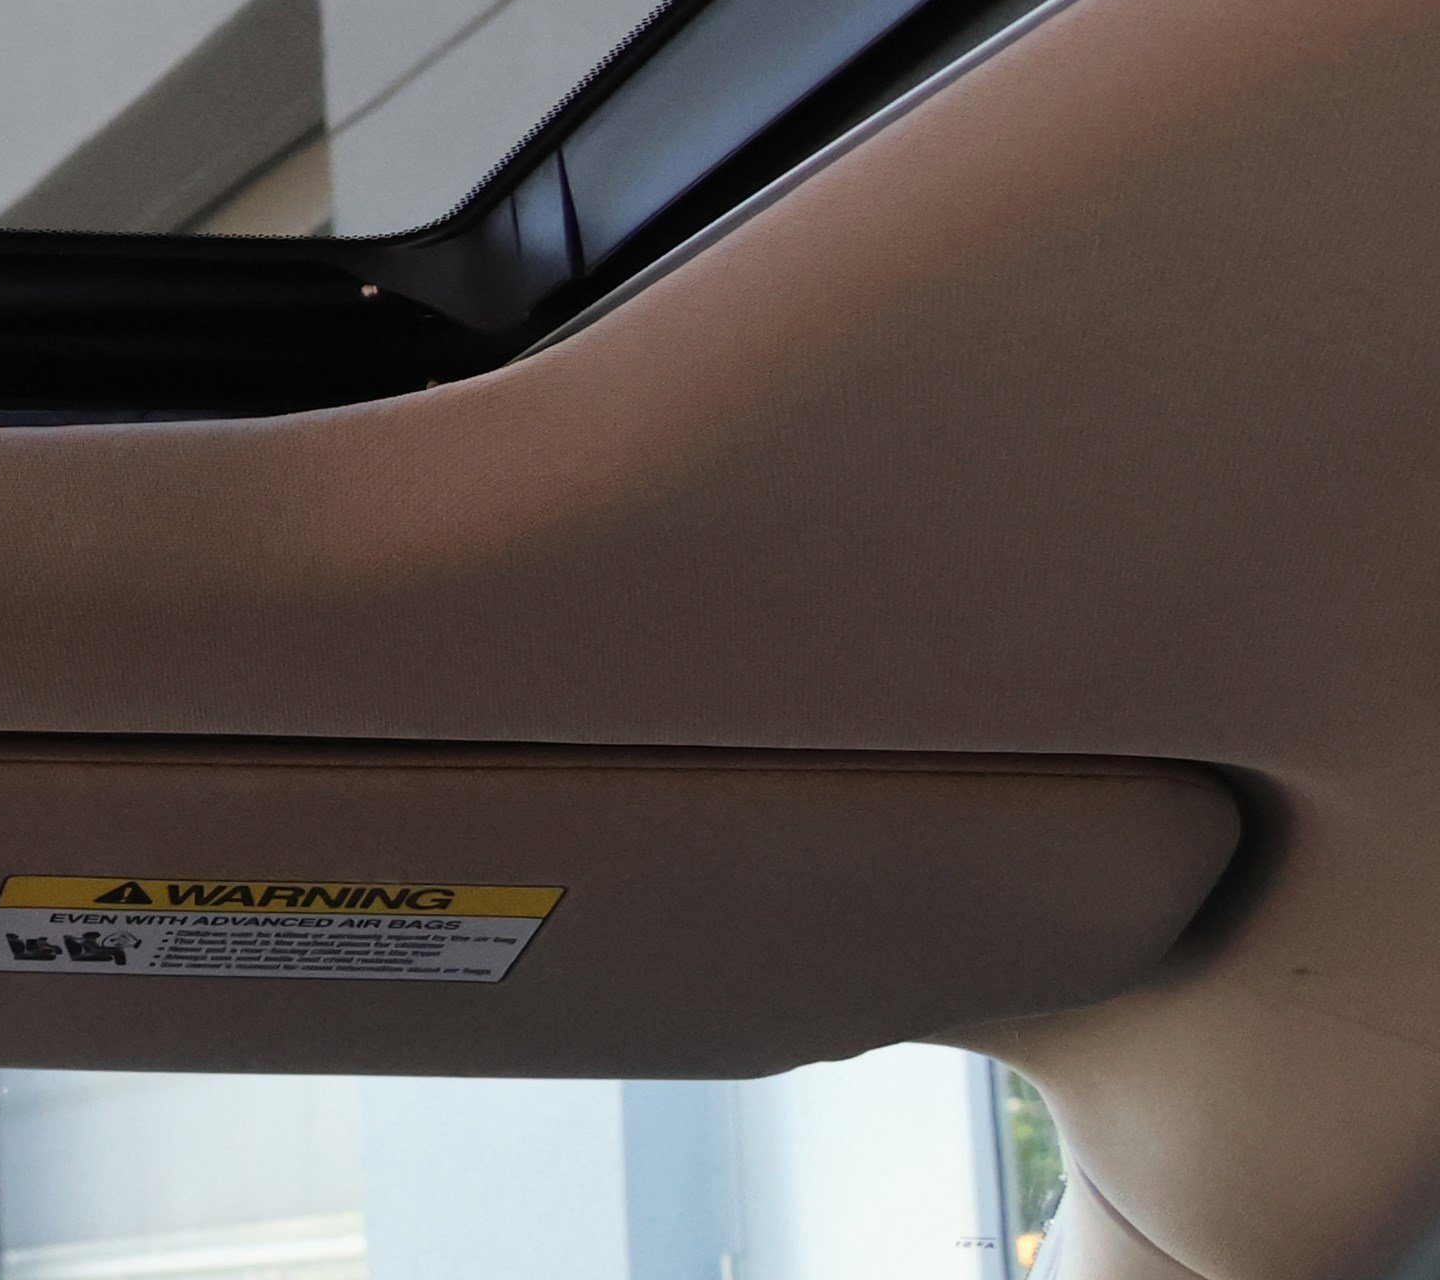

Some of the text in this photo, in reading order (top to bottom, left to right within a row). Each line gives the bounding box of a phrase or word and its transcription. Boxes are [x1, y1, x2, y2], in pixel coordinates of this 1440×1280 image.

[166, 885, 455, 910] WARNING
[49, 913, 462, 931] EVEN WITH ADVANCED AIR BAGS
